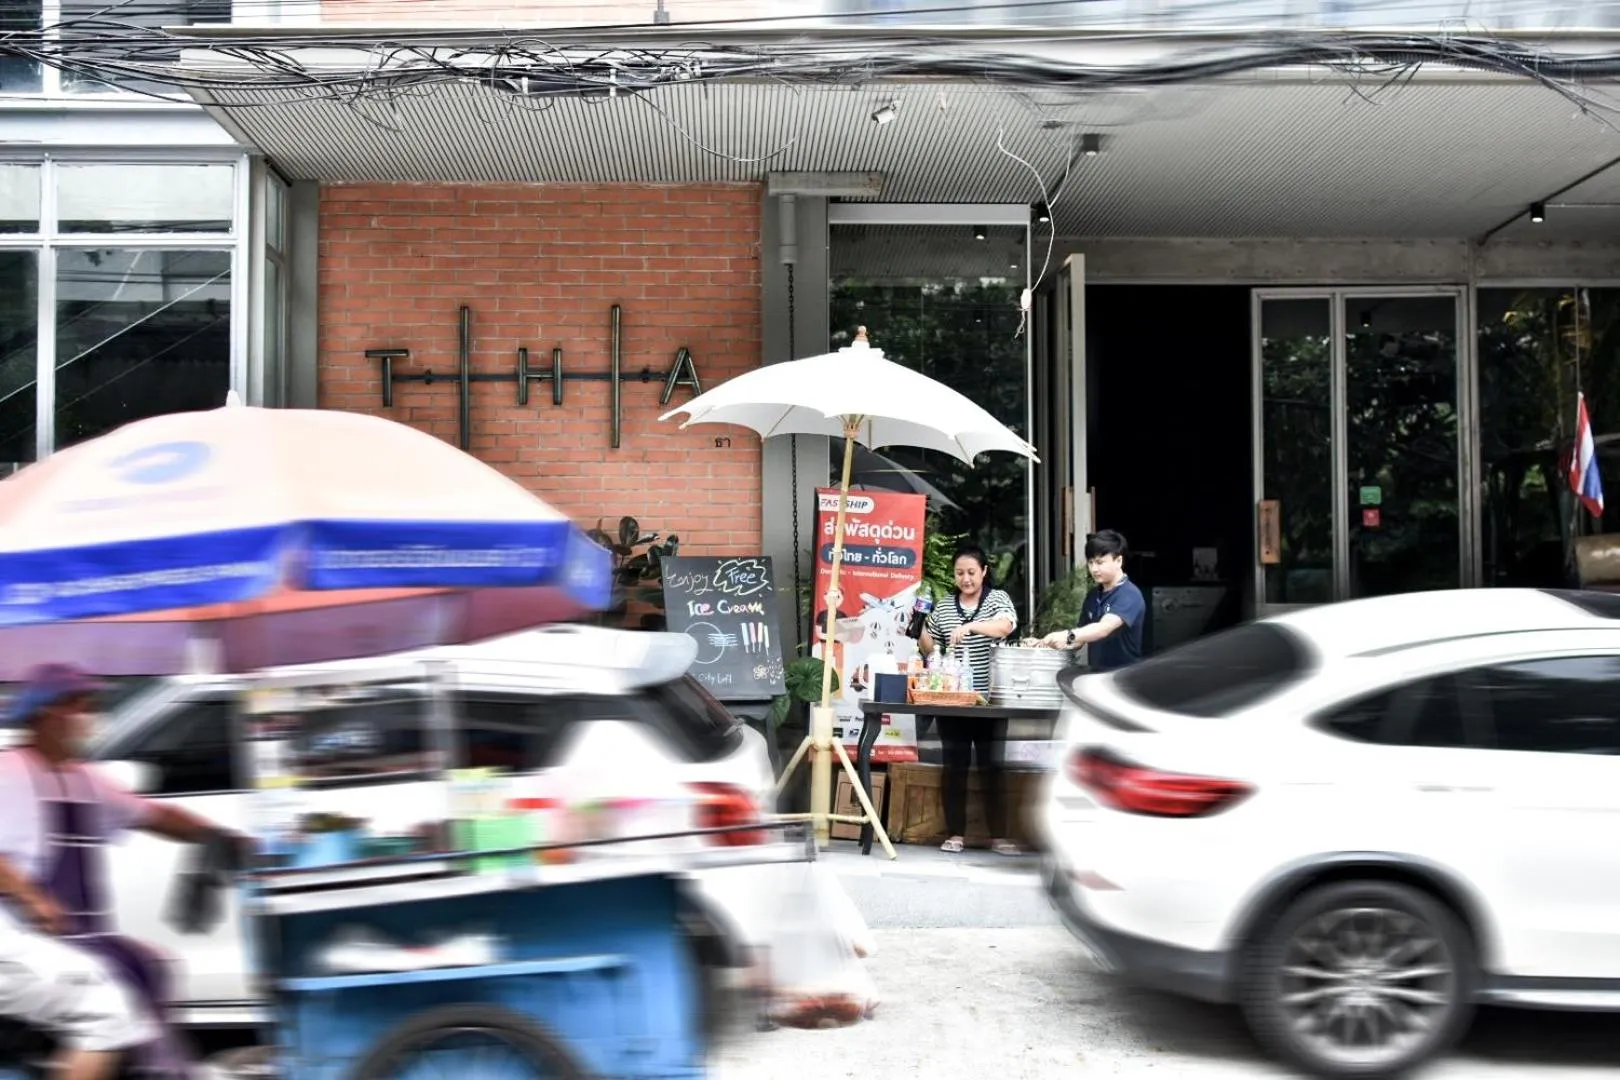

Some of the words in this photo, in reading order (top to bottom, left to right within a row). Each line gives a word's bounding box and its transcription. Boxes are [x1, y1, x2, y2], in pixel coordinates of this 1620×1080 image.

[824, 517, 916, 545] ส่พัสดุด่วน
[725, 567, 757, 584] Free
[687, 600, 714, 617] Ice
[717, 599, 765, 615] Cream
